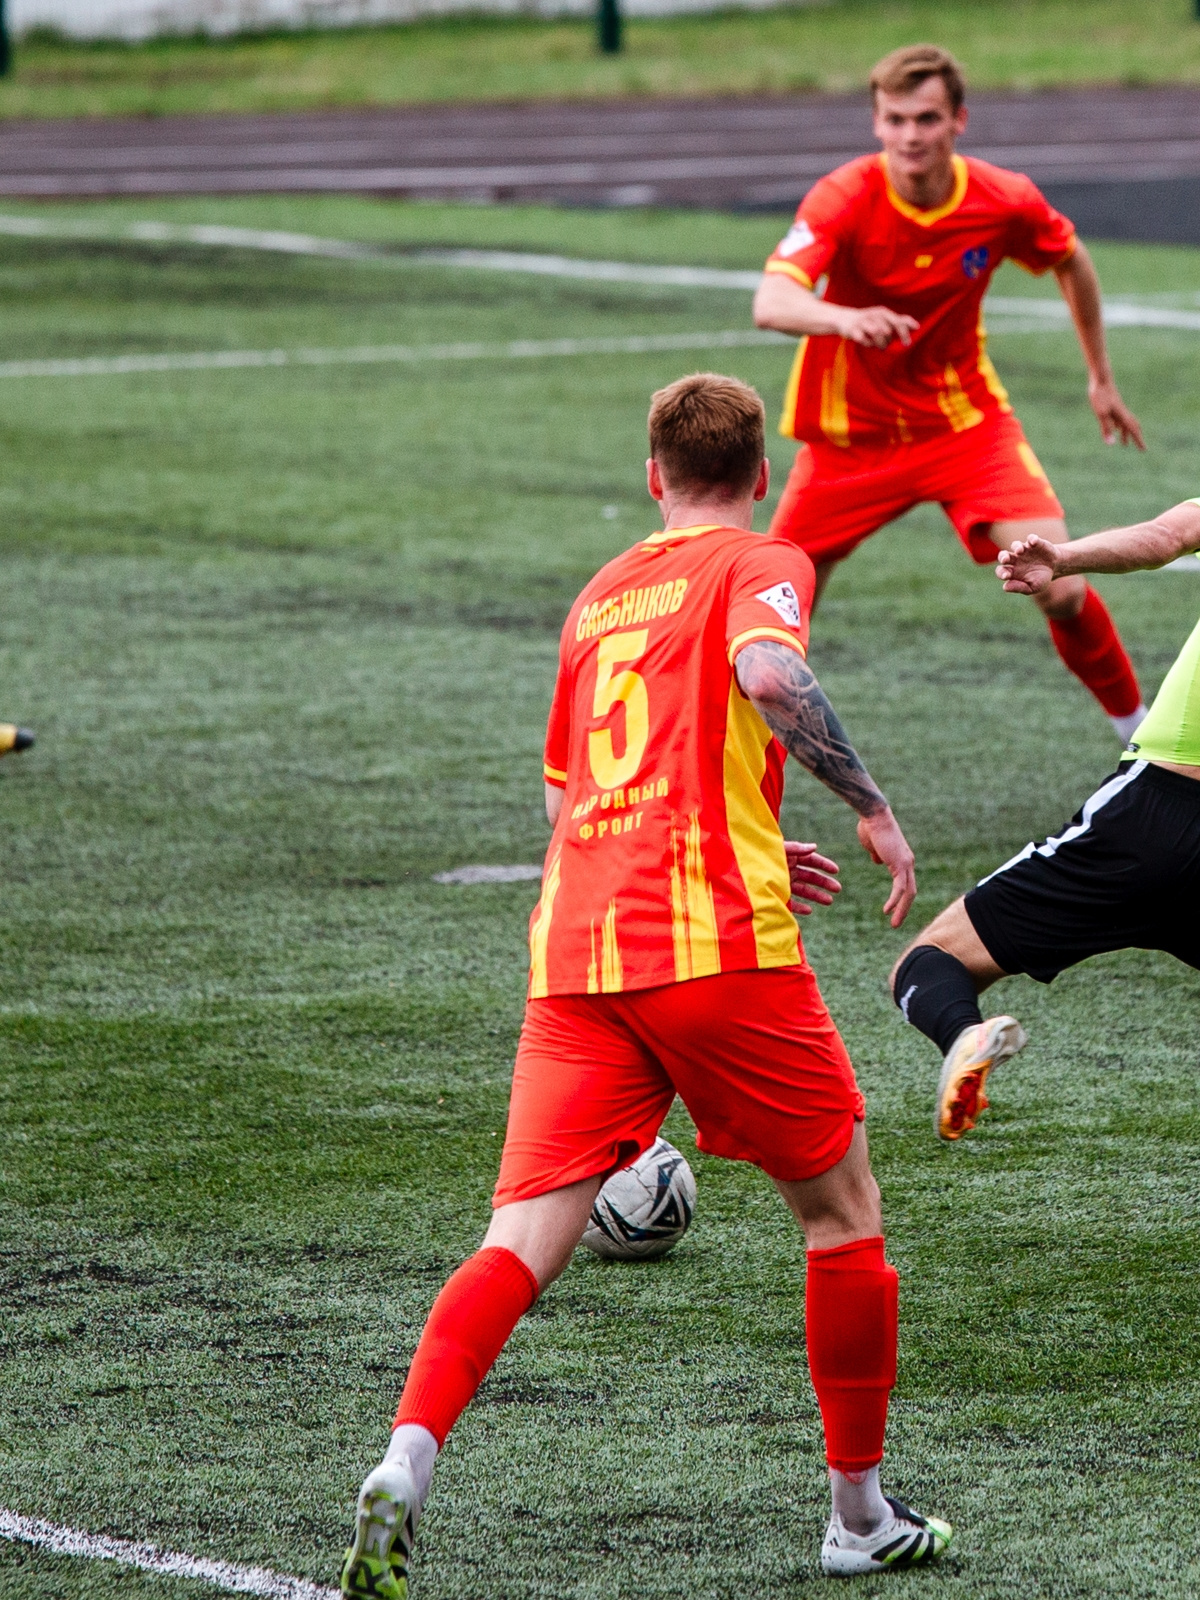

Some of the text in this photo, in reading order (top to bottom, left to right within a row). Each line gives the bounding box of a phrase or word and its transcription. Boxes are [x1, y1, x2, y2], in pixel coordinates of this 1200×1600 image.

[575, 577, 689, 642] САЛЬНИКОВ
[588, 628, 650, 789] 5
[571, 777, 669, 820] НАРОДНЫЙ
[579, 811, 644, 840] ФРОНТ
